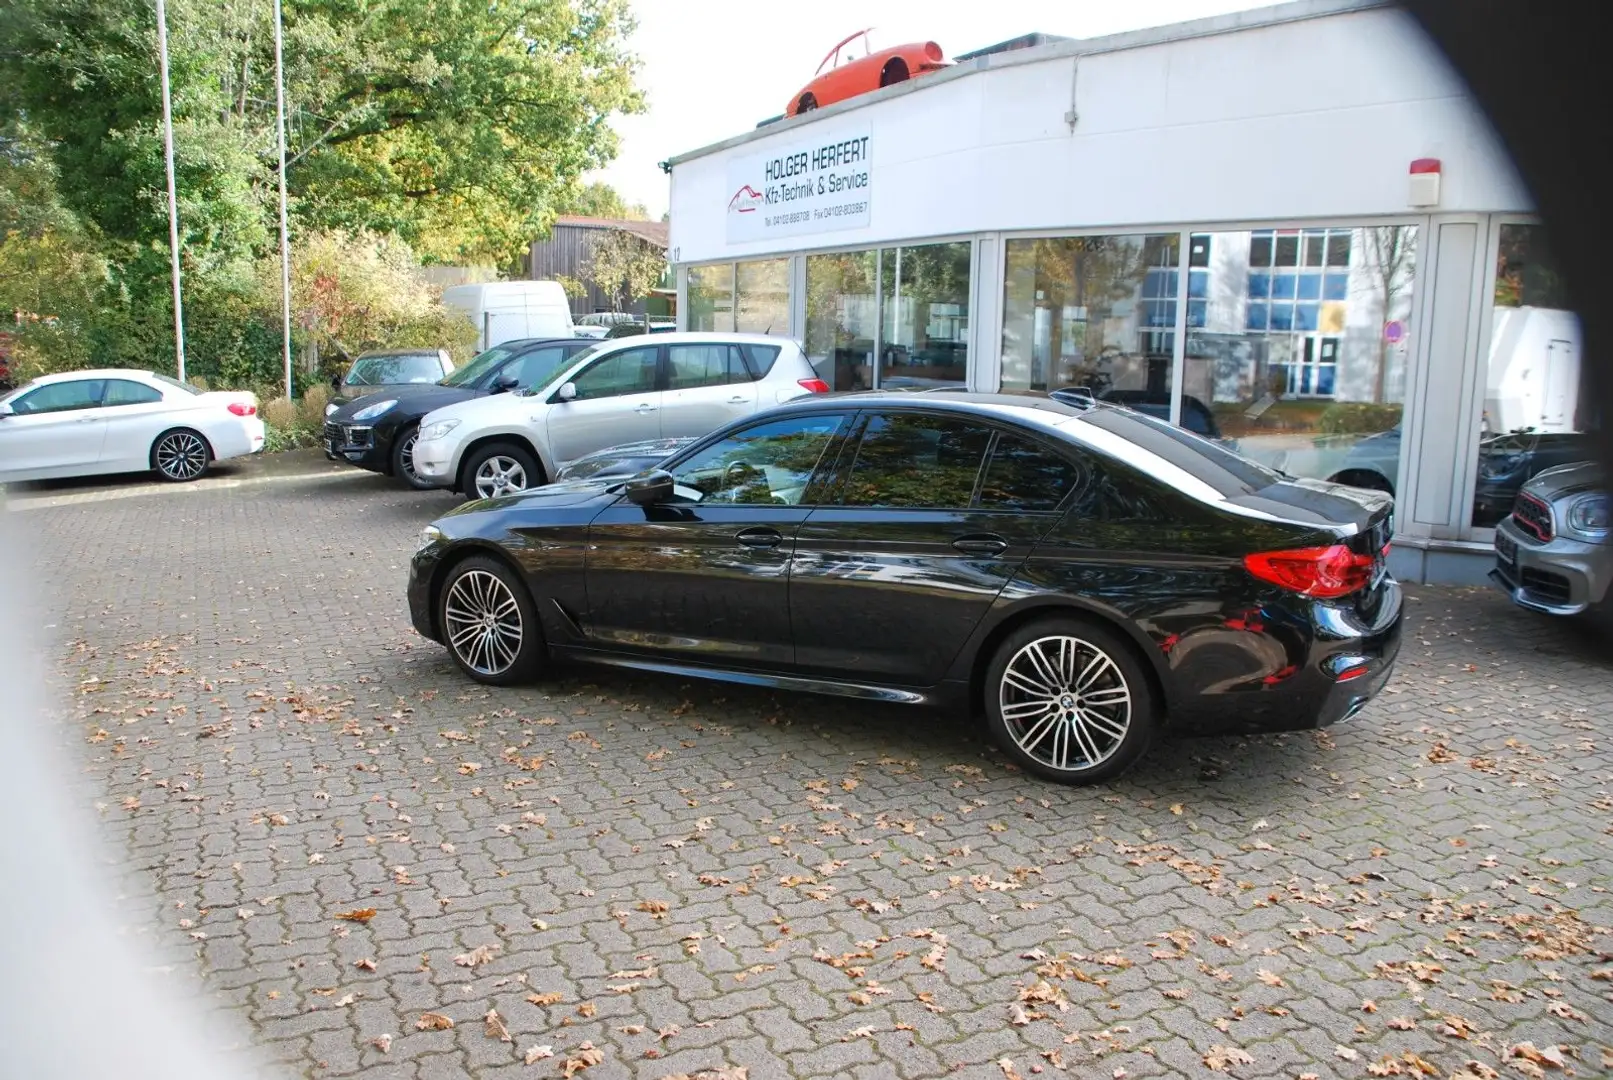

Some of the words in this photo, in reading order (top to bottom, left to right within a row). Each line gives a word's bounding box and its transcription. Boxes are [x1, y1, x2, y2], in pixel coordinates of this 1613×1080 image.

[765, 152, 808, 181] HOLGER
[812, 137, 869, 171] HERFERT
[765, 177, 814, 205] Kfz-Technik
[818, 176, 825, 194] &
[829, 169, 868, 194] Service
[674, 246, 681, 262] 12
